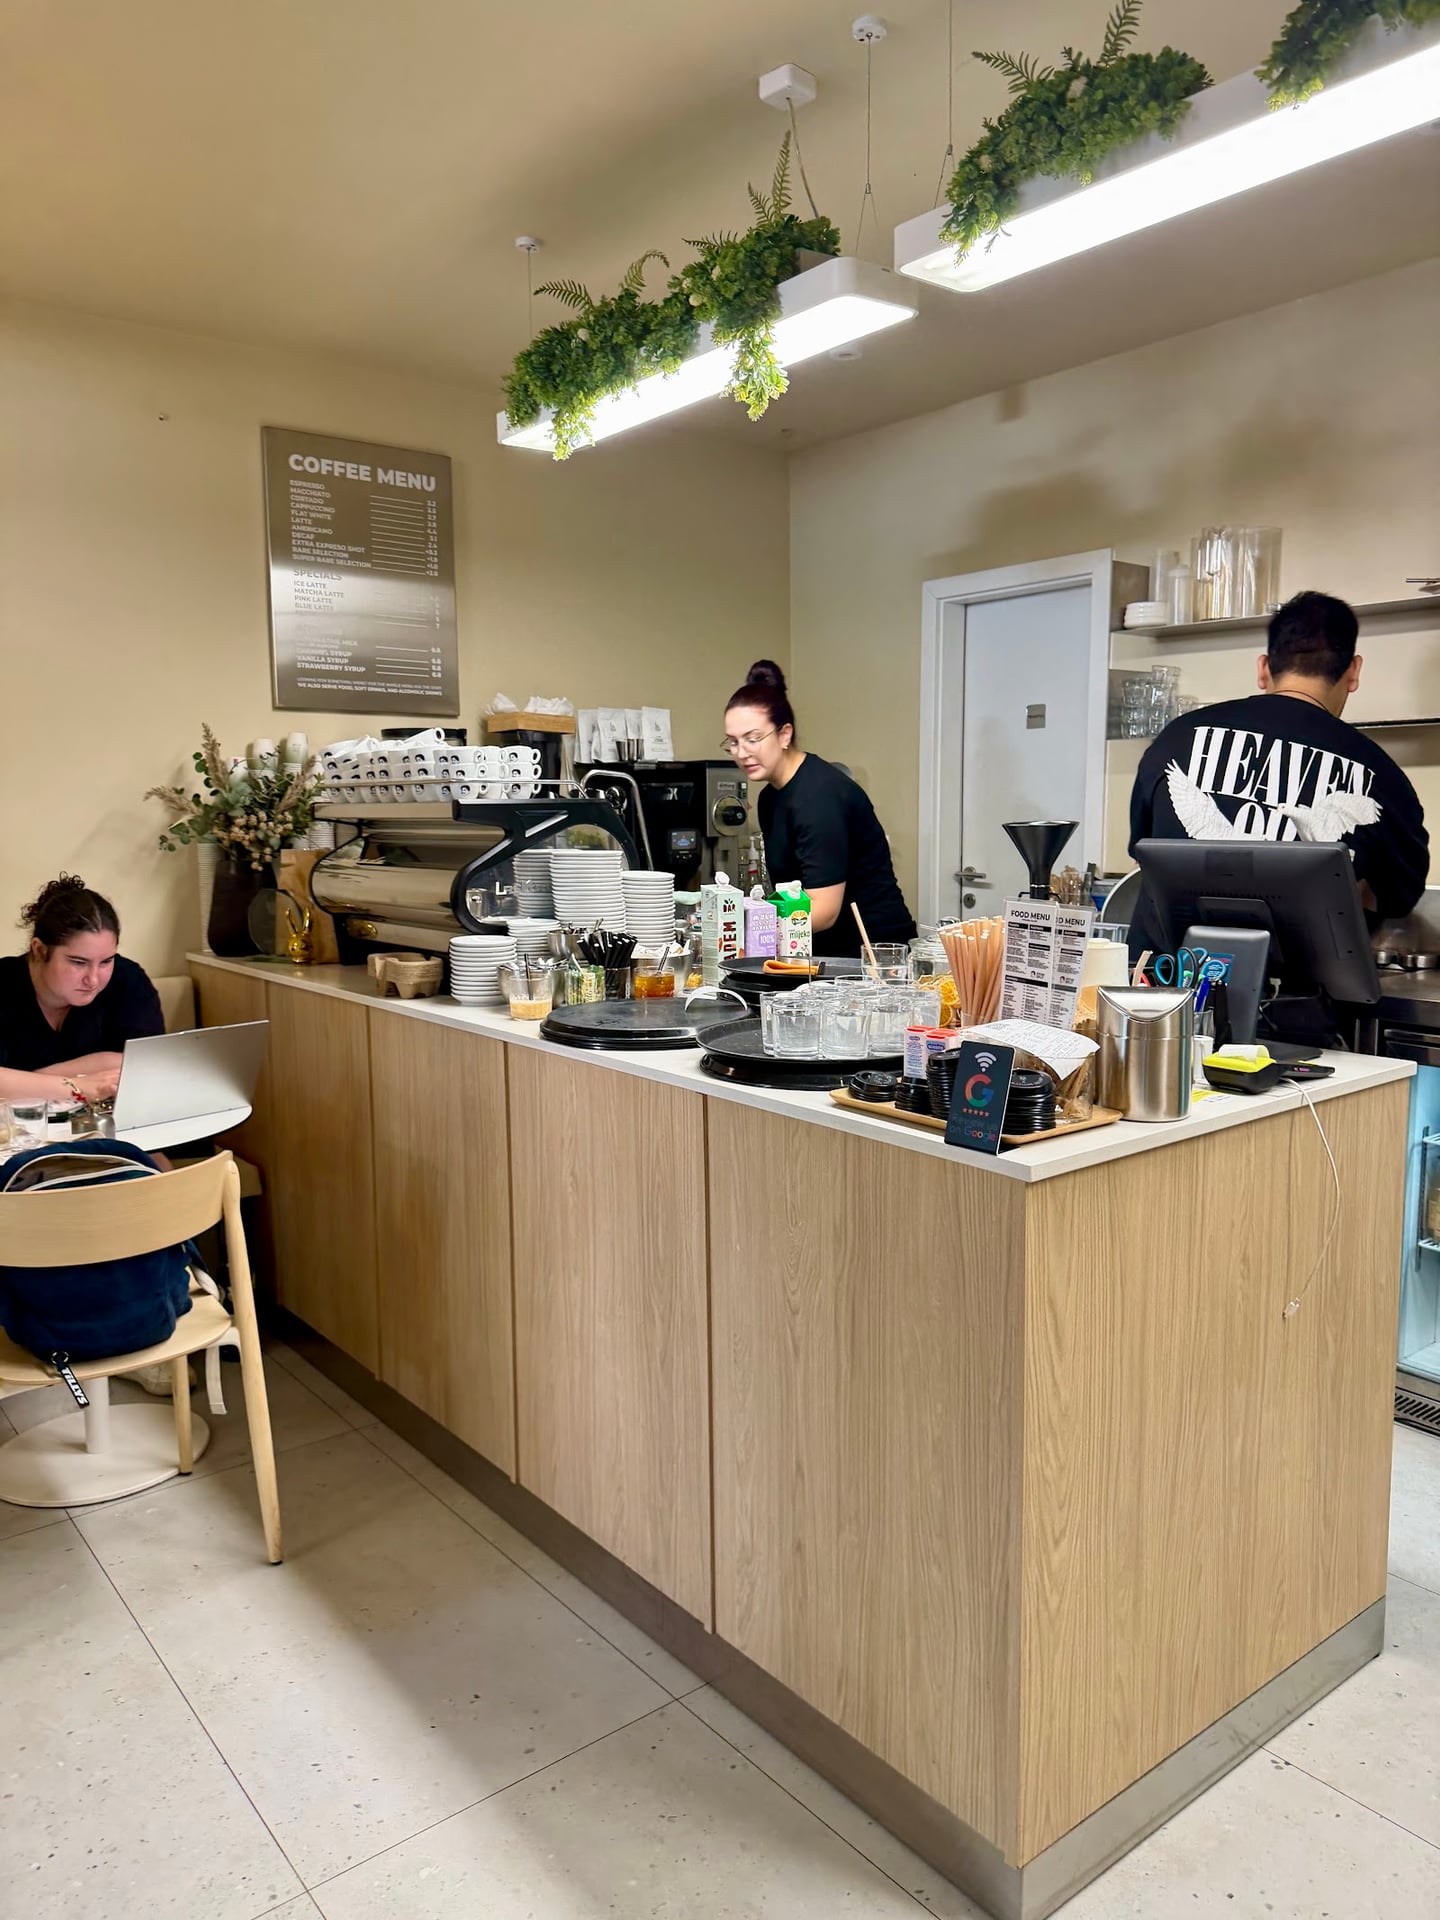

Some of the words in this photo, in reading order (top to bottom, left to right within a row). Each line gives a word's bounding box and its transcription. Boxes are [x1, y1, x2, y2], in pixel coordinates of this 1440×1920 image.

[288, 454, 372, 481] COFFEE
[377, 467, 436, 492] MENU
[290, 487, 331, 498] MACCHIATO
[291, 502, 335, 513] CAPPUCCINO
[291, 509, 308, 517] FLAT
[309, 512, 332, 520] WHITE
[291, 517, 312, 525] LATTE
[291, 524, 333, 535] AMERICANO
[291, 531, 314, 539] DECAF
[292, 539, 314, 547] EXTRA
[312, 548, 349, 559] SELECTION
[336, 559, 372, 569] SELECTION
[293, 568, 343, 580] SPECIALS
[294, 588, 323, 596] MATCHA
[296, 655, 326, 663] VANILLA
[297, 662, 343, 671] STRAWBERRY
[1187, 726, 1376, 808] HEAVEN
[1011, 909, 1030, 919] FOOD
[1030, 912, 1051, 921] MENU
[1065, 917, 1086, 926] MENU
[964, 1126, 997, 1142] Google
